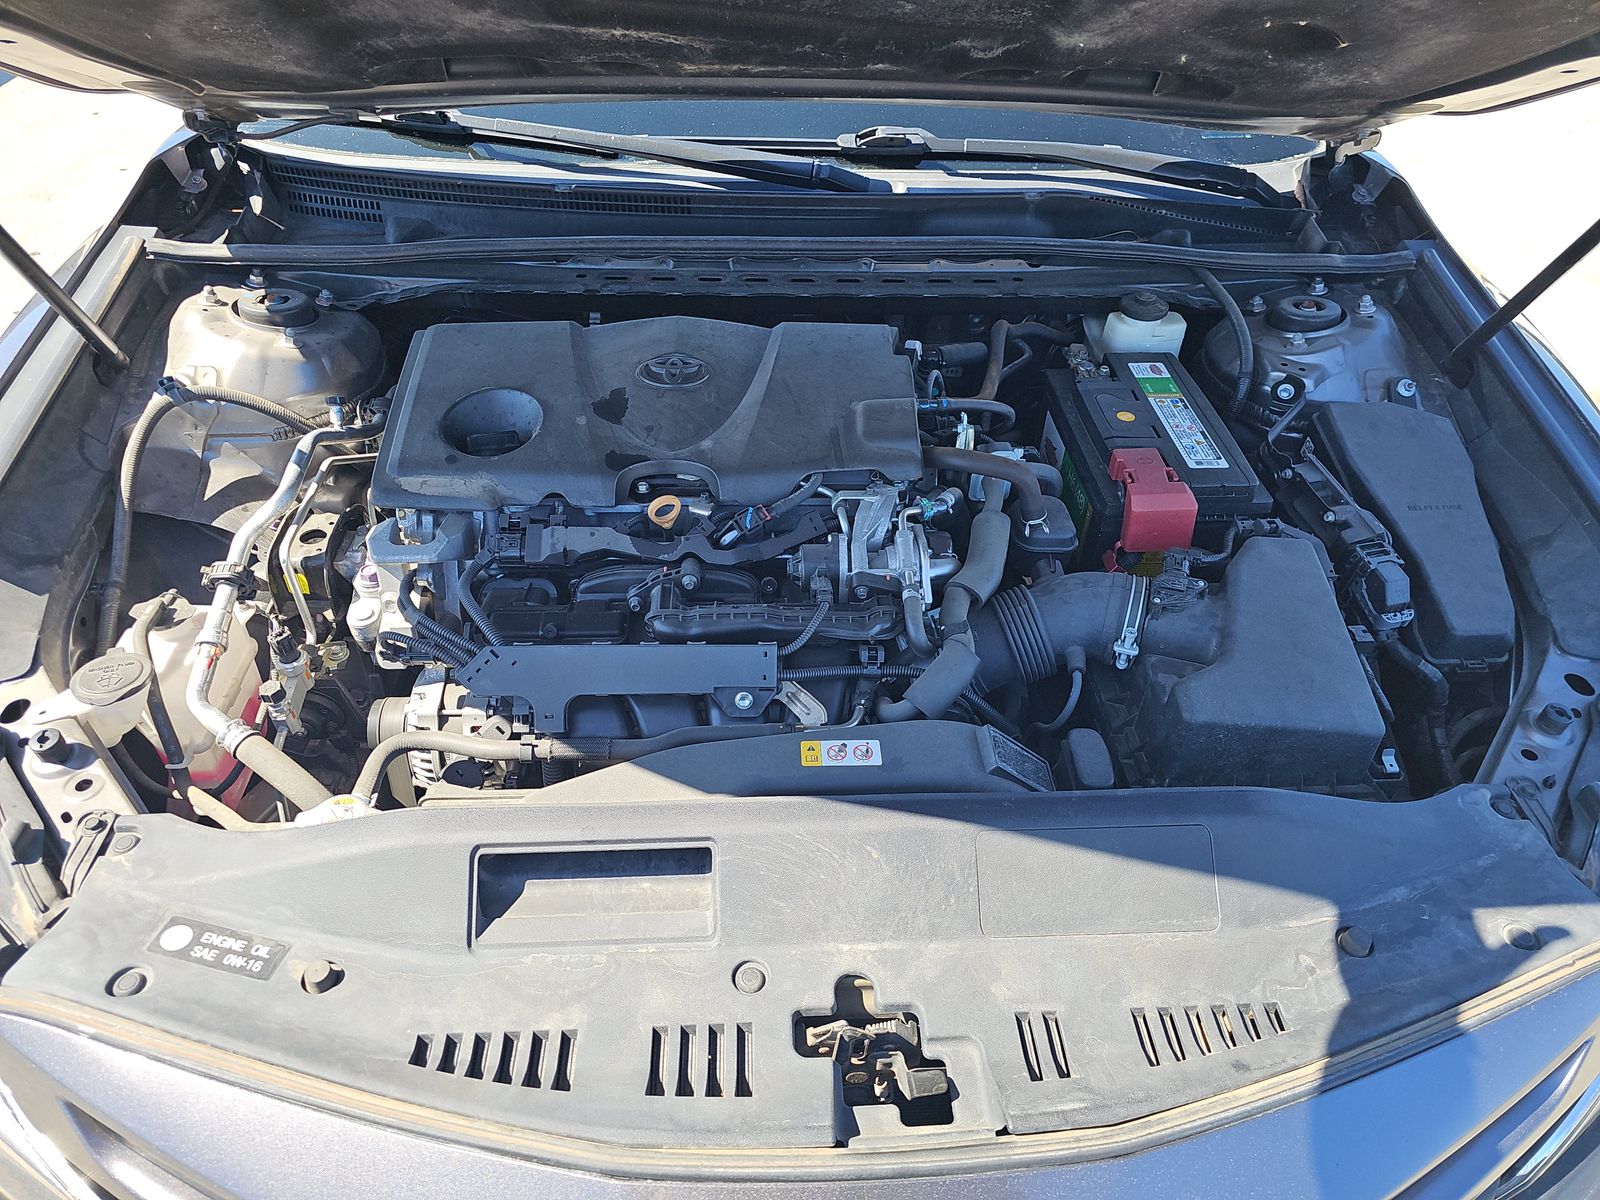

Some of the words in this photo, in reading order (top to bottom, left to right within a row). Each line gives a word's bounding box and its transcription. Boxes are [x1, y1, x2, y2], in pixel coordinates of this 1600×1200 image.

[1407, 504, 1433, 512] RELAY
[190, 945, 220, 961] SAE
[222, 953, 264, 972] 0W-16
[200, 931, 248, 952] ENGINE
[250, 944, 271, 959] OIL
